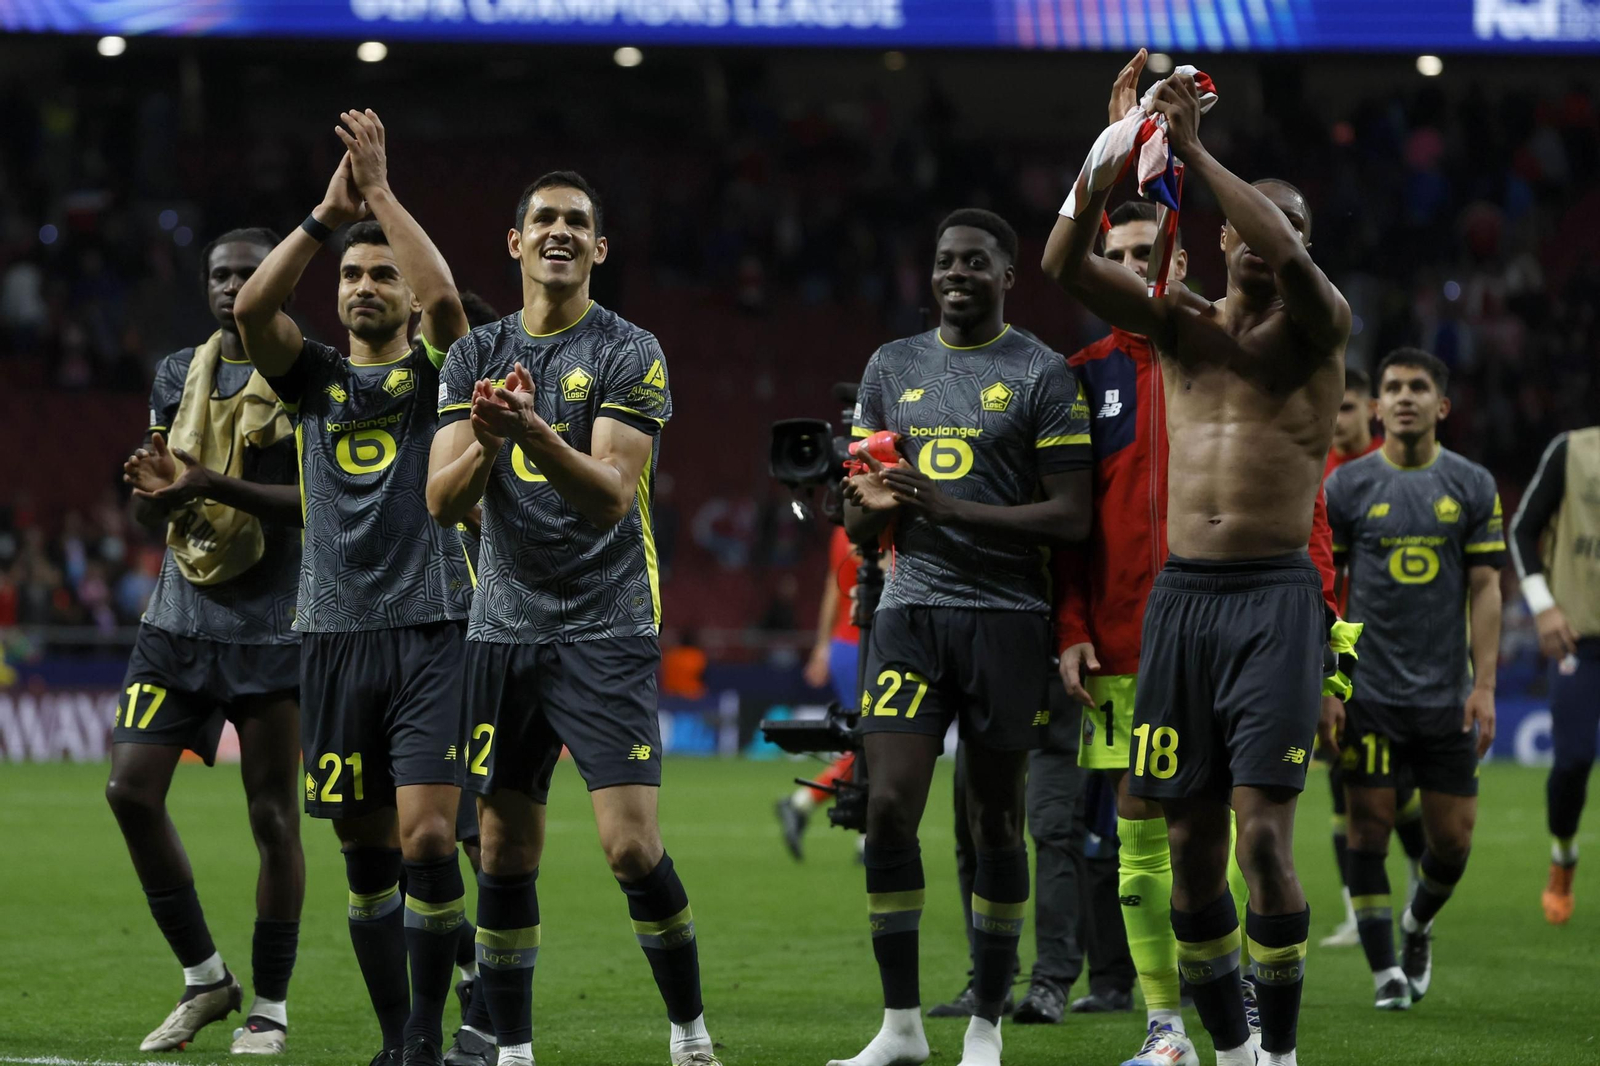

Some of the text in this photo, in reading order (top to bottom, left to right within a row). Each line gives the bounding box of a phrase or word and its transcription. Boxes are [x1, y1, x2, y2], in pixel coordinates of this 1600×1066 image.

[567, 392, 586, 400] LOSC
[985, 401, 1004, 410] LOSC
[326, 412, 404, 432] boulanger
[909, 425, 984, 438] boulanger
[124, 682, 167, 730] 17
[873, 669, 929, 719] 27
[1100, 700, 1114, 747] 1
[471, 723, 495, 777] 2
[1133, 723, 1180, 780] 18
[1361, 732, 1390, 775] 11
[318, 752, 364, 802] 21
[482, 948, 522, 965] LOSC
[1257, 966, 1299, 981] LOSC
